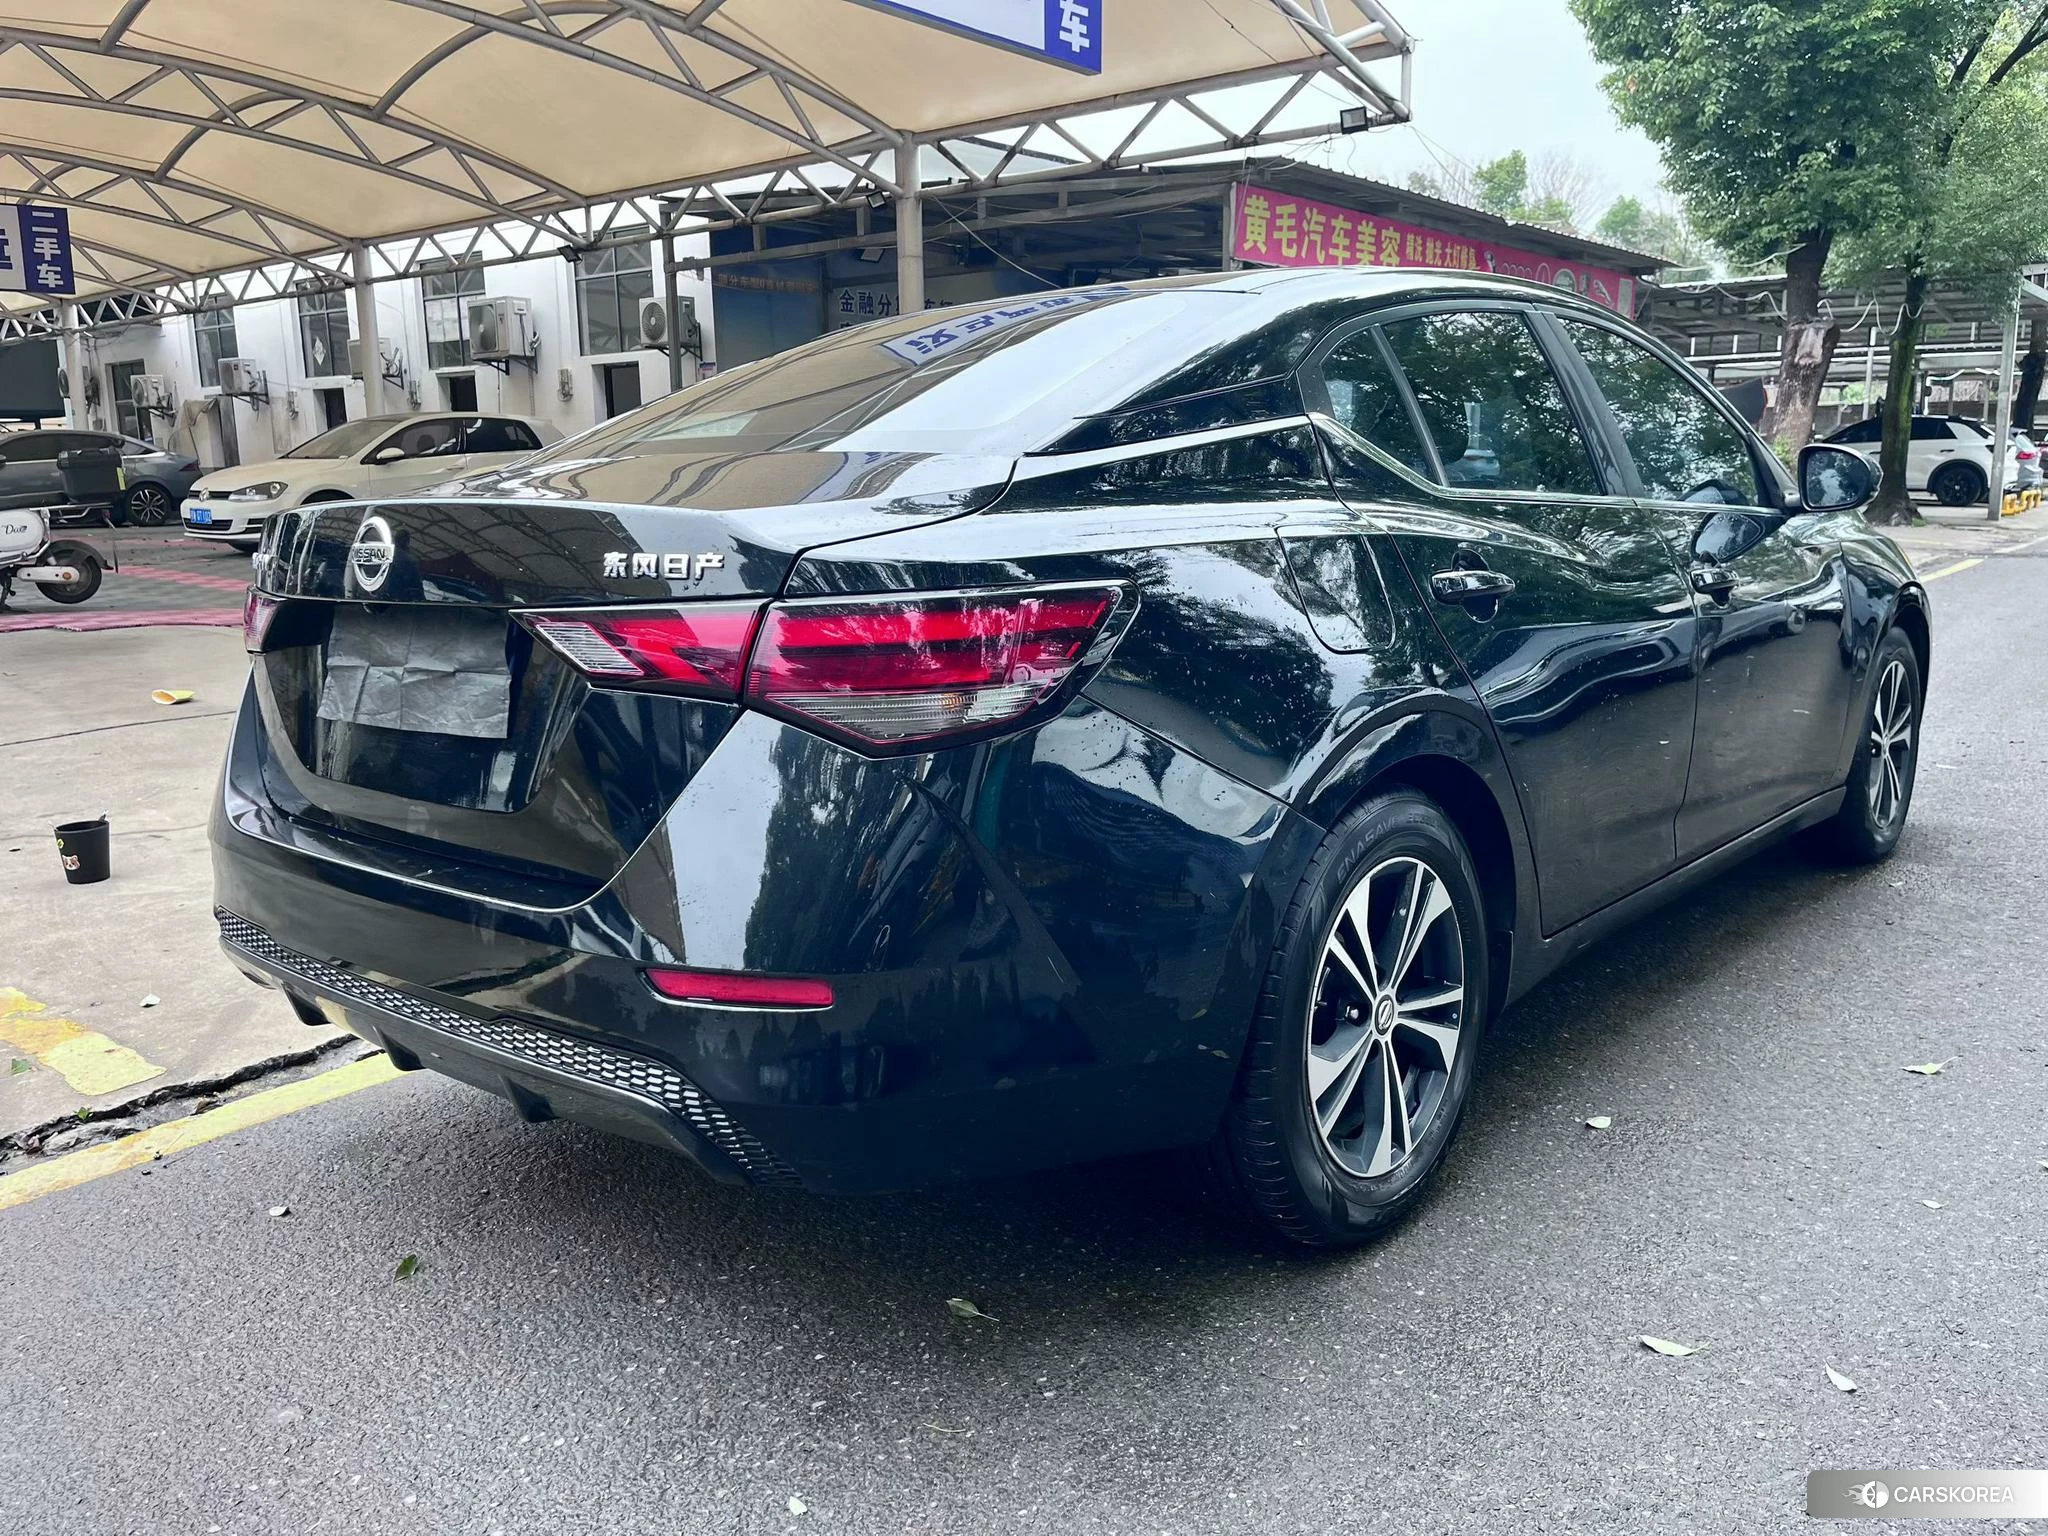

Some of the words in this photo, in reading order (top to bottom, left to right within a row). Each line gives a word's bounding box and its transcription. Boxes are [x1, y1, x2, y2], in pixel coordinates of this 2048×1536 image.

[31, 211, 64, 288] 二手车
[1243, 194, 1401, 267] 黄毛汽车美容
[603, 552, 724, 580] 东风日产
[1337, 815, 1398, 884] ENASAVE
